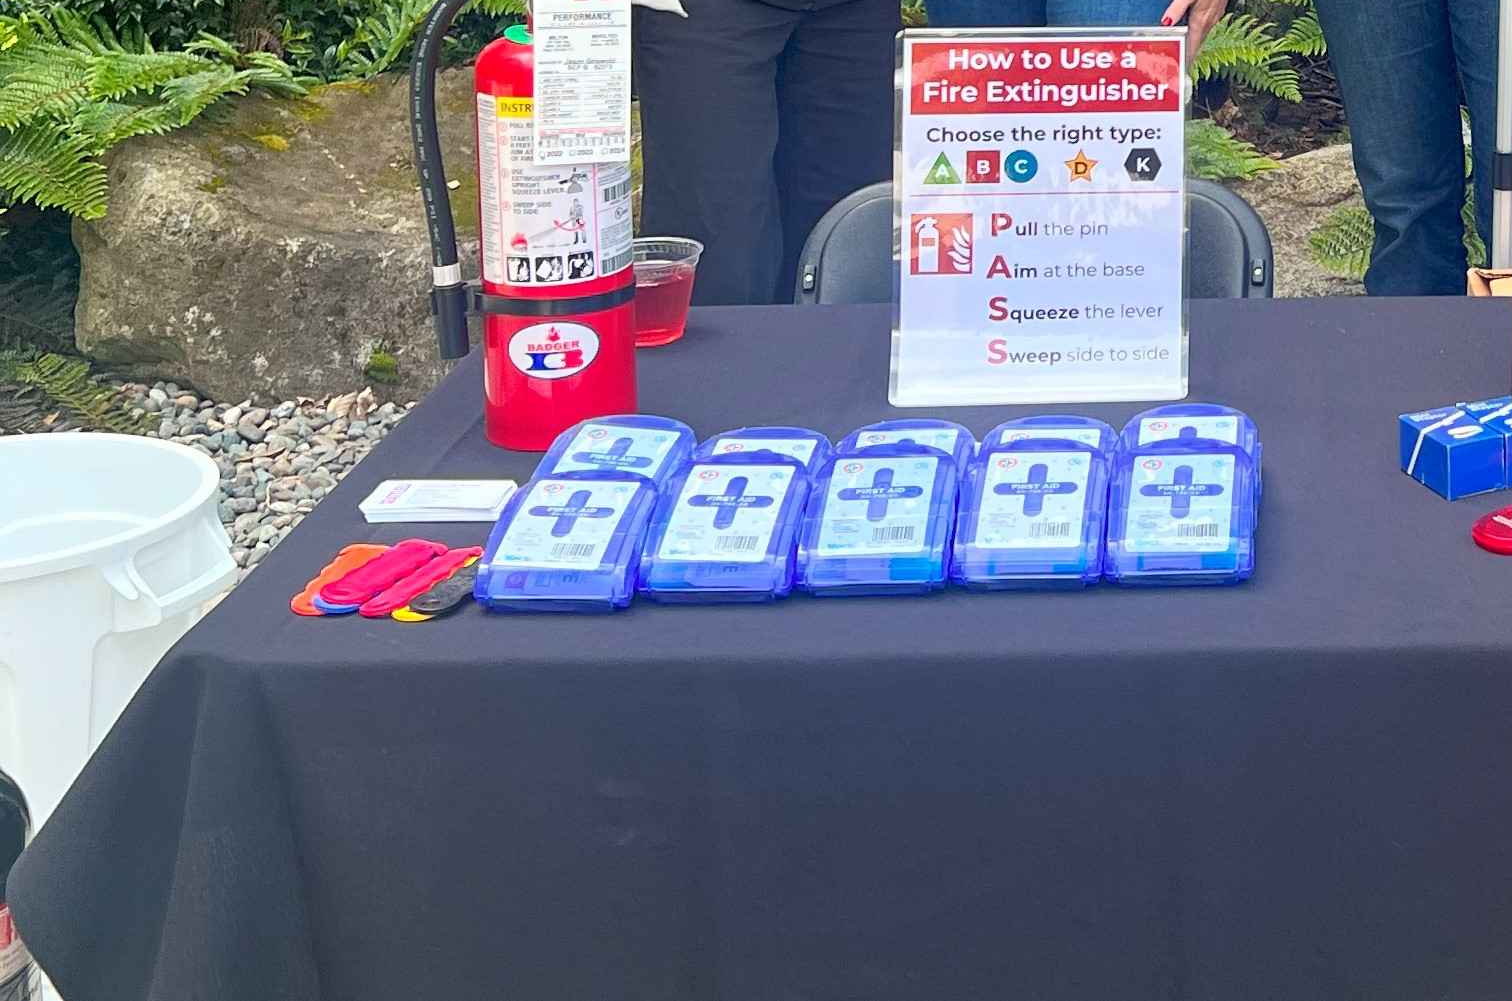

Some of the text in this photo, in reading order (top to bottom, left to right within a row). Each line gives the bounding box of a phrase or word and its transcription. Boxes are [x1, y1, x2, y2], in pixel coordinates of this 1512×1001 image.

[949, 48, 1136, 70] How to Use a
[923, 78, 1169, 106] Fire Extinguisher
[926, 125, 1162, 144] Choose the right type:
[935, 157, 1151, 176] A B C D K
[991, 213, 1108, 238] Pull the pin
[986, 255, 1145, 279] Aim at the base
[988, 297, 1164, 323] Squeeze the lever
[528, 341, 579, 351] BADGER
[988, 339, 1169, 365] Sweep side to side
